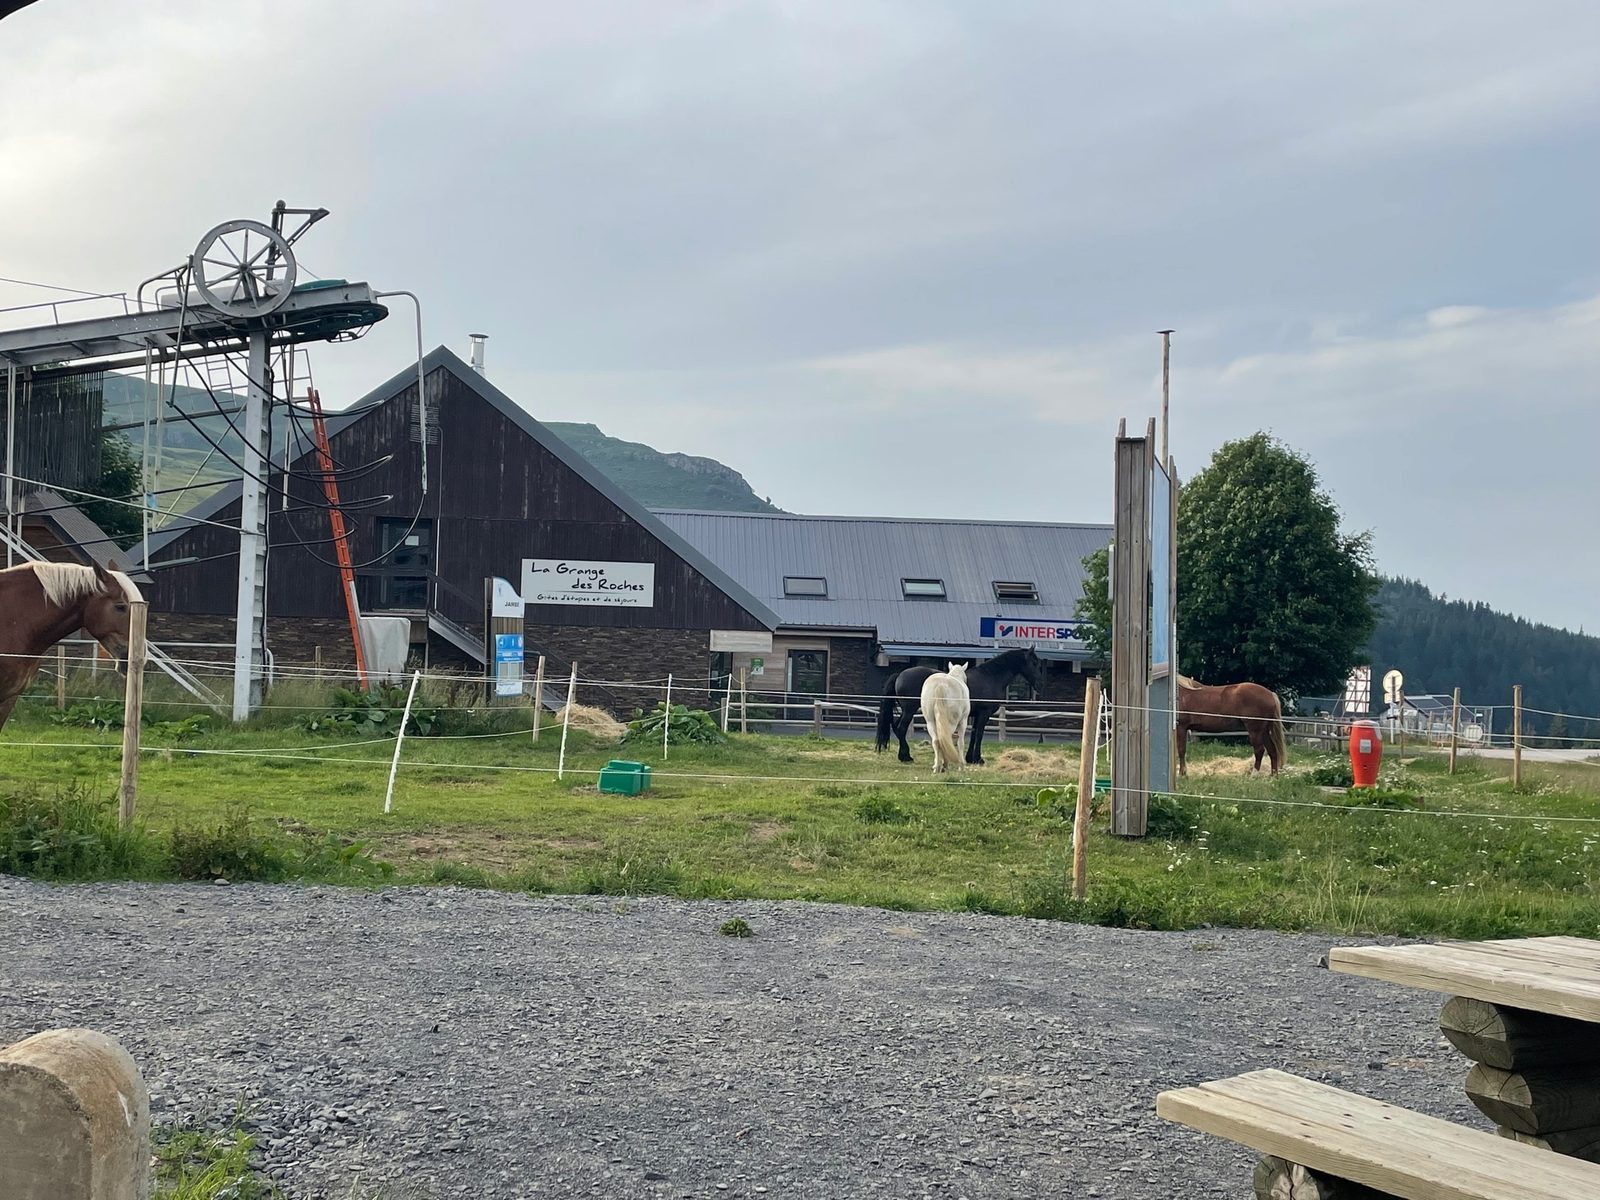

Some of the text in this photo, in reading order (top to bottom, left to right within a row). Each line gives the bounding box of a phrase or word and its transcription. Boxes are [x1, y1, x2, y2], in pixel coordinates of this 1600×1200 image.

[531, 562, 605, 580] La Grange
[571, 578, 645, 591] des Roches
[1015, 626, 1082, 640] INTERSPO
